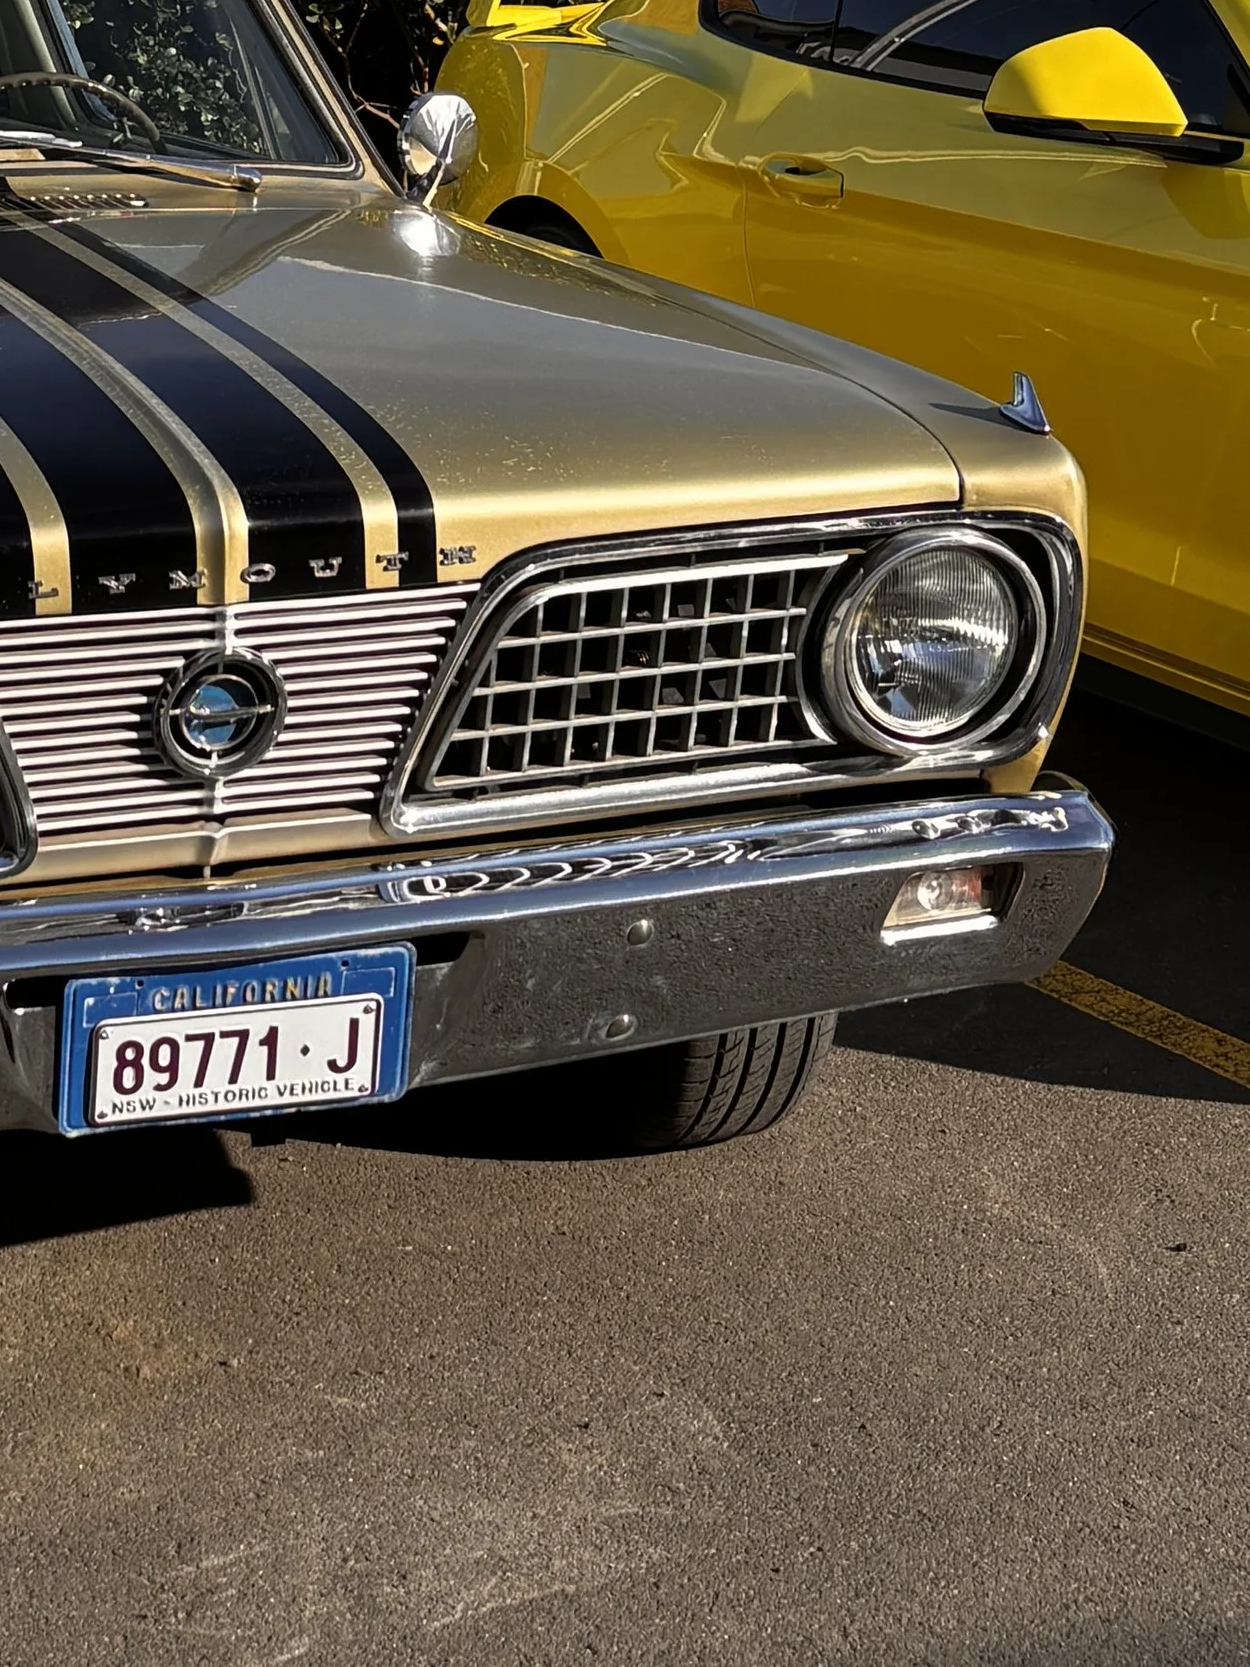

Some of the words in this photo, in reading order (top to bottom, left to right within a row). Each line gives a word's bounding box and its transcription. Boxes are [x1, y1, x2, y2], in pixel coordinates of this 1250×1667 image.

[152, 970, 333, 1012] CALIFORNIA
[111, 1097, 158, 1115] NSW
[178, 1086, 269, 1109] HISTORIC
[277, 1076, 355, 1098] VEHICLE
